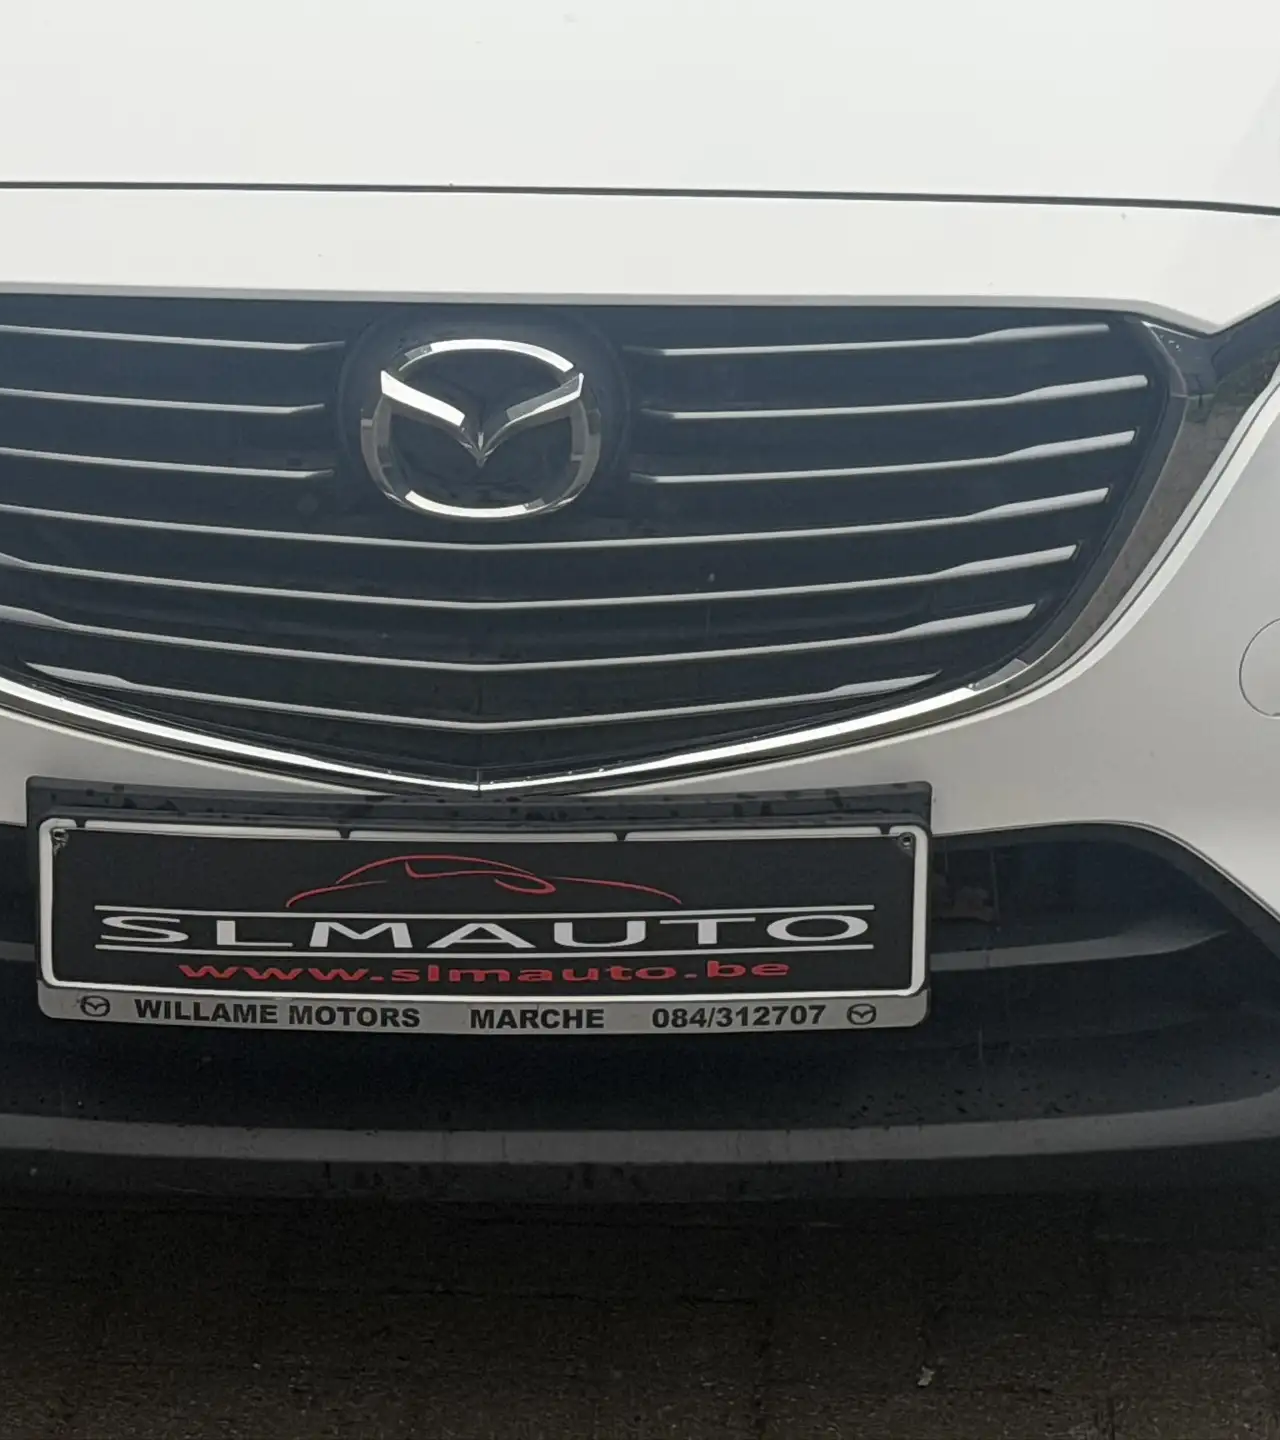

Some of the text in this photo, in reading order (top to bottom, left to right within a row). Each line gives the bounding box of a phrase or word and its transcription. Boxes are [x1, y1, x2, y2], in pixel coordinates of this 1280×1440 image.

[100, 913, 870, 949] SLMAUTO
[178, 959, 790, 984] www.slmauto.be
[133, 998, 827, 1030] WILLAME MOTORS MARCHE 084/312707
